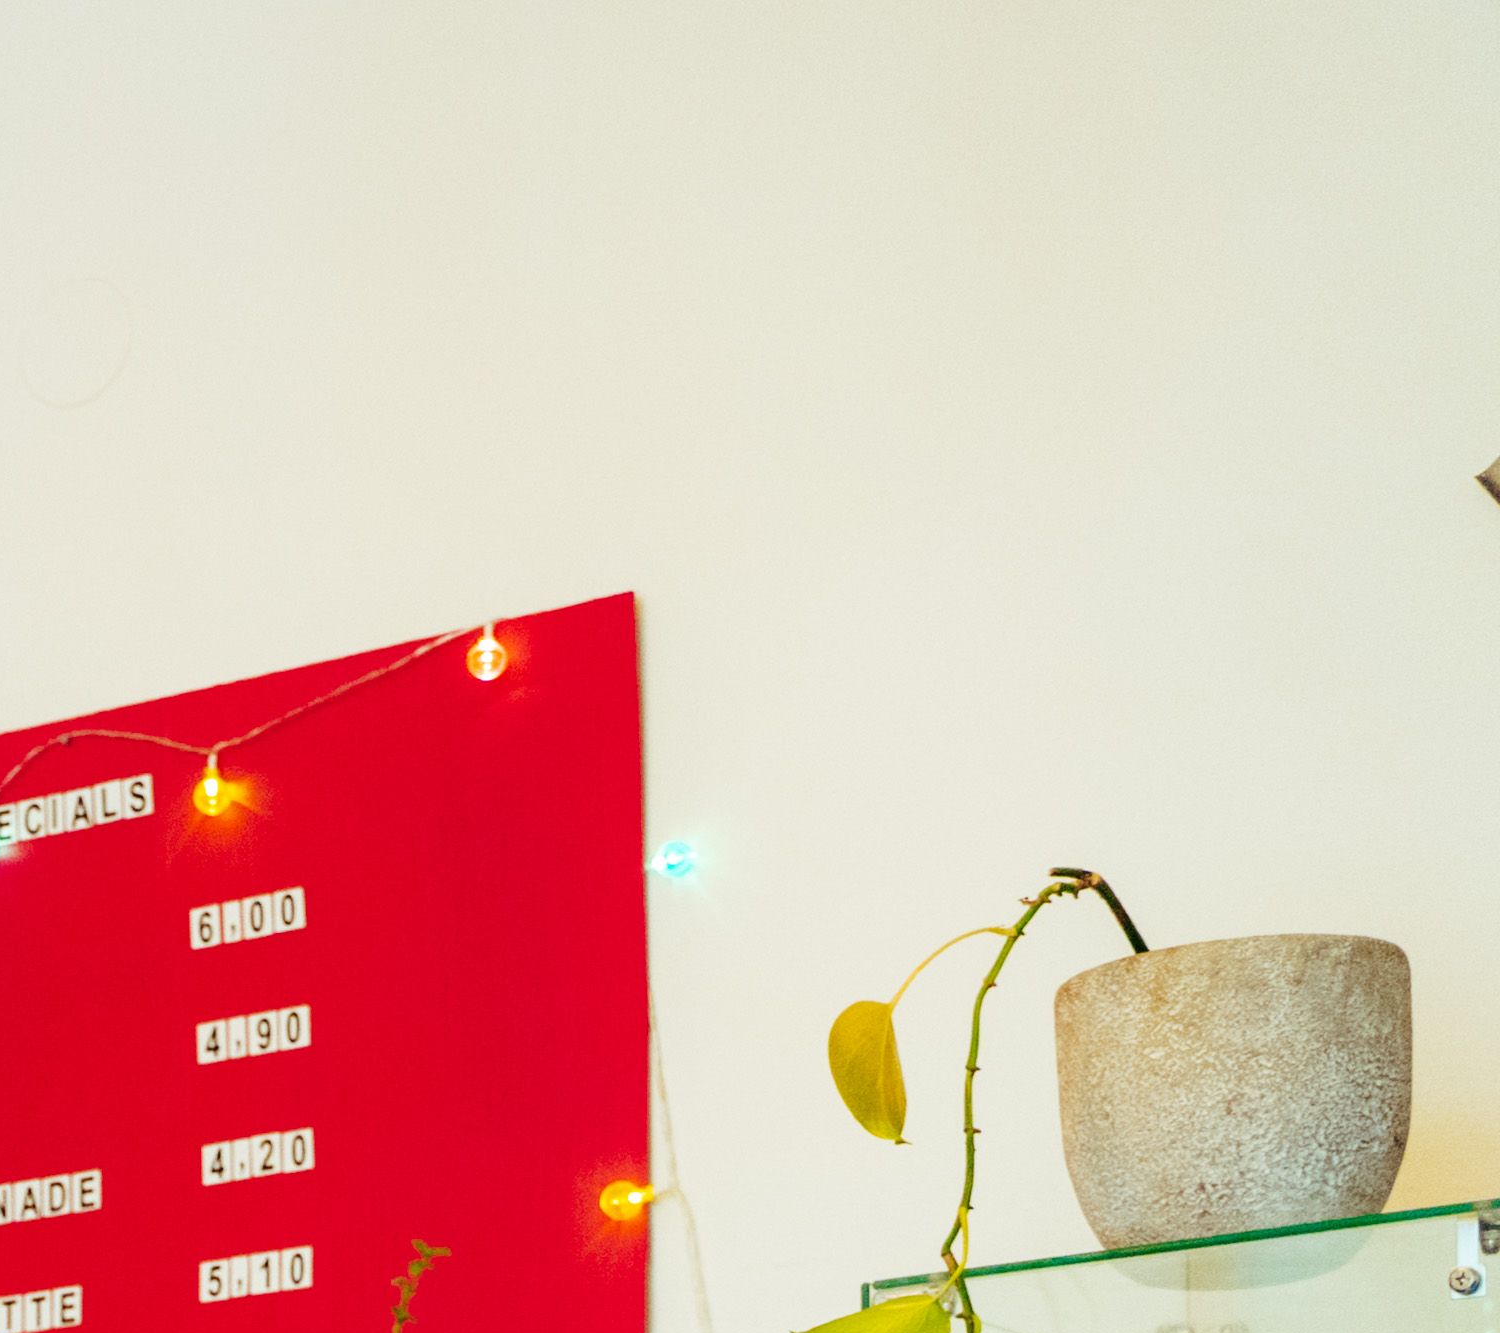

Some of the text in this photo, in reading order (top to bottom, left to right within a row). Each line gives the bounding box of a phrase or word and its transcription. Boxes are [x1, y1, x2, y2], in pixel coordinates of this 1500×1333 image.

[197, 893, 297, 944] 6,00
[205, 1011, 302, 1057] 4,90
[209, 1134, 307, 1180] 4,20
[207, 1252, 306, 1298] 5,10
